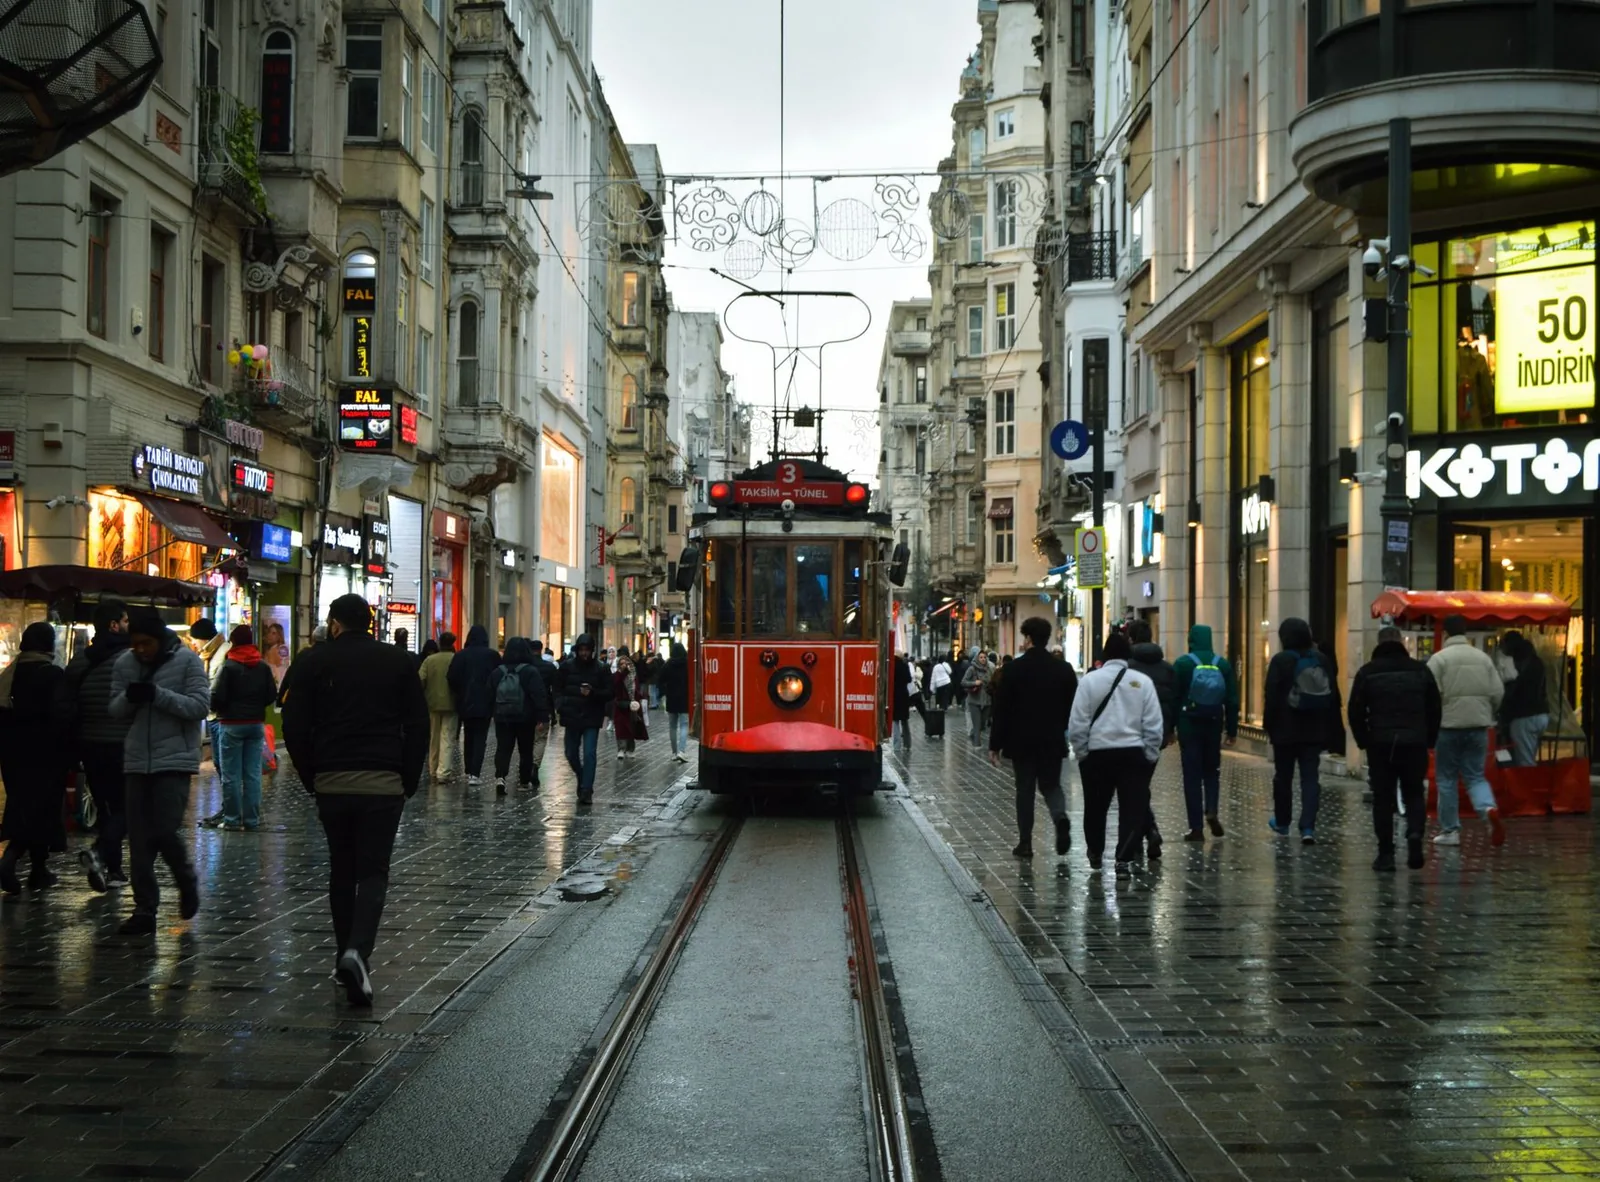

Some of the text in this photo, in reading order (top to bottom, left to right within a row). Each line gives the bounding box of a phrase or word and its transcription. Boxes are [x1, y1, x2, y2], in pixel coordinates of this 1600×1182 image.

[346, 289, 374, 300] FAL
[1538, 295, 1586, 343] 50
[355, 390, 380, 403] FAL
[145, 445, 204, 477] TARİHİ BEYOĞLU
[152, 465, 198, 495] ÇİKOLATACISI
[244, 465, 268, 492] TATTOO
[782, 463, 796, 484] 3
[740, 486, 779, 497] TAKSİM
[794, 486, 828, 499] TÜNEL
[861, 660, 873, 676] 410
